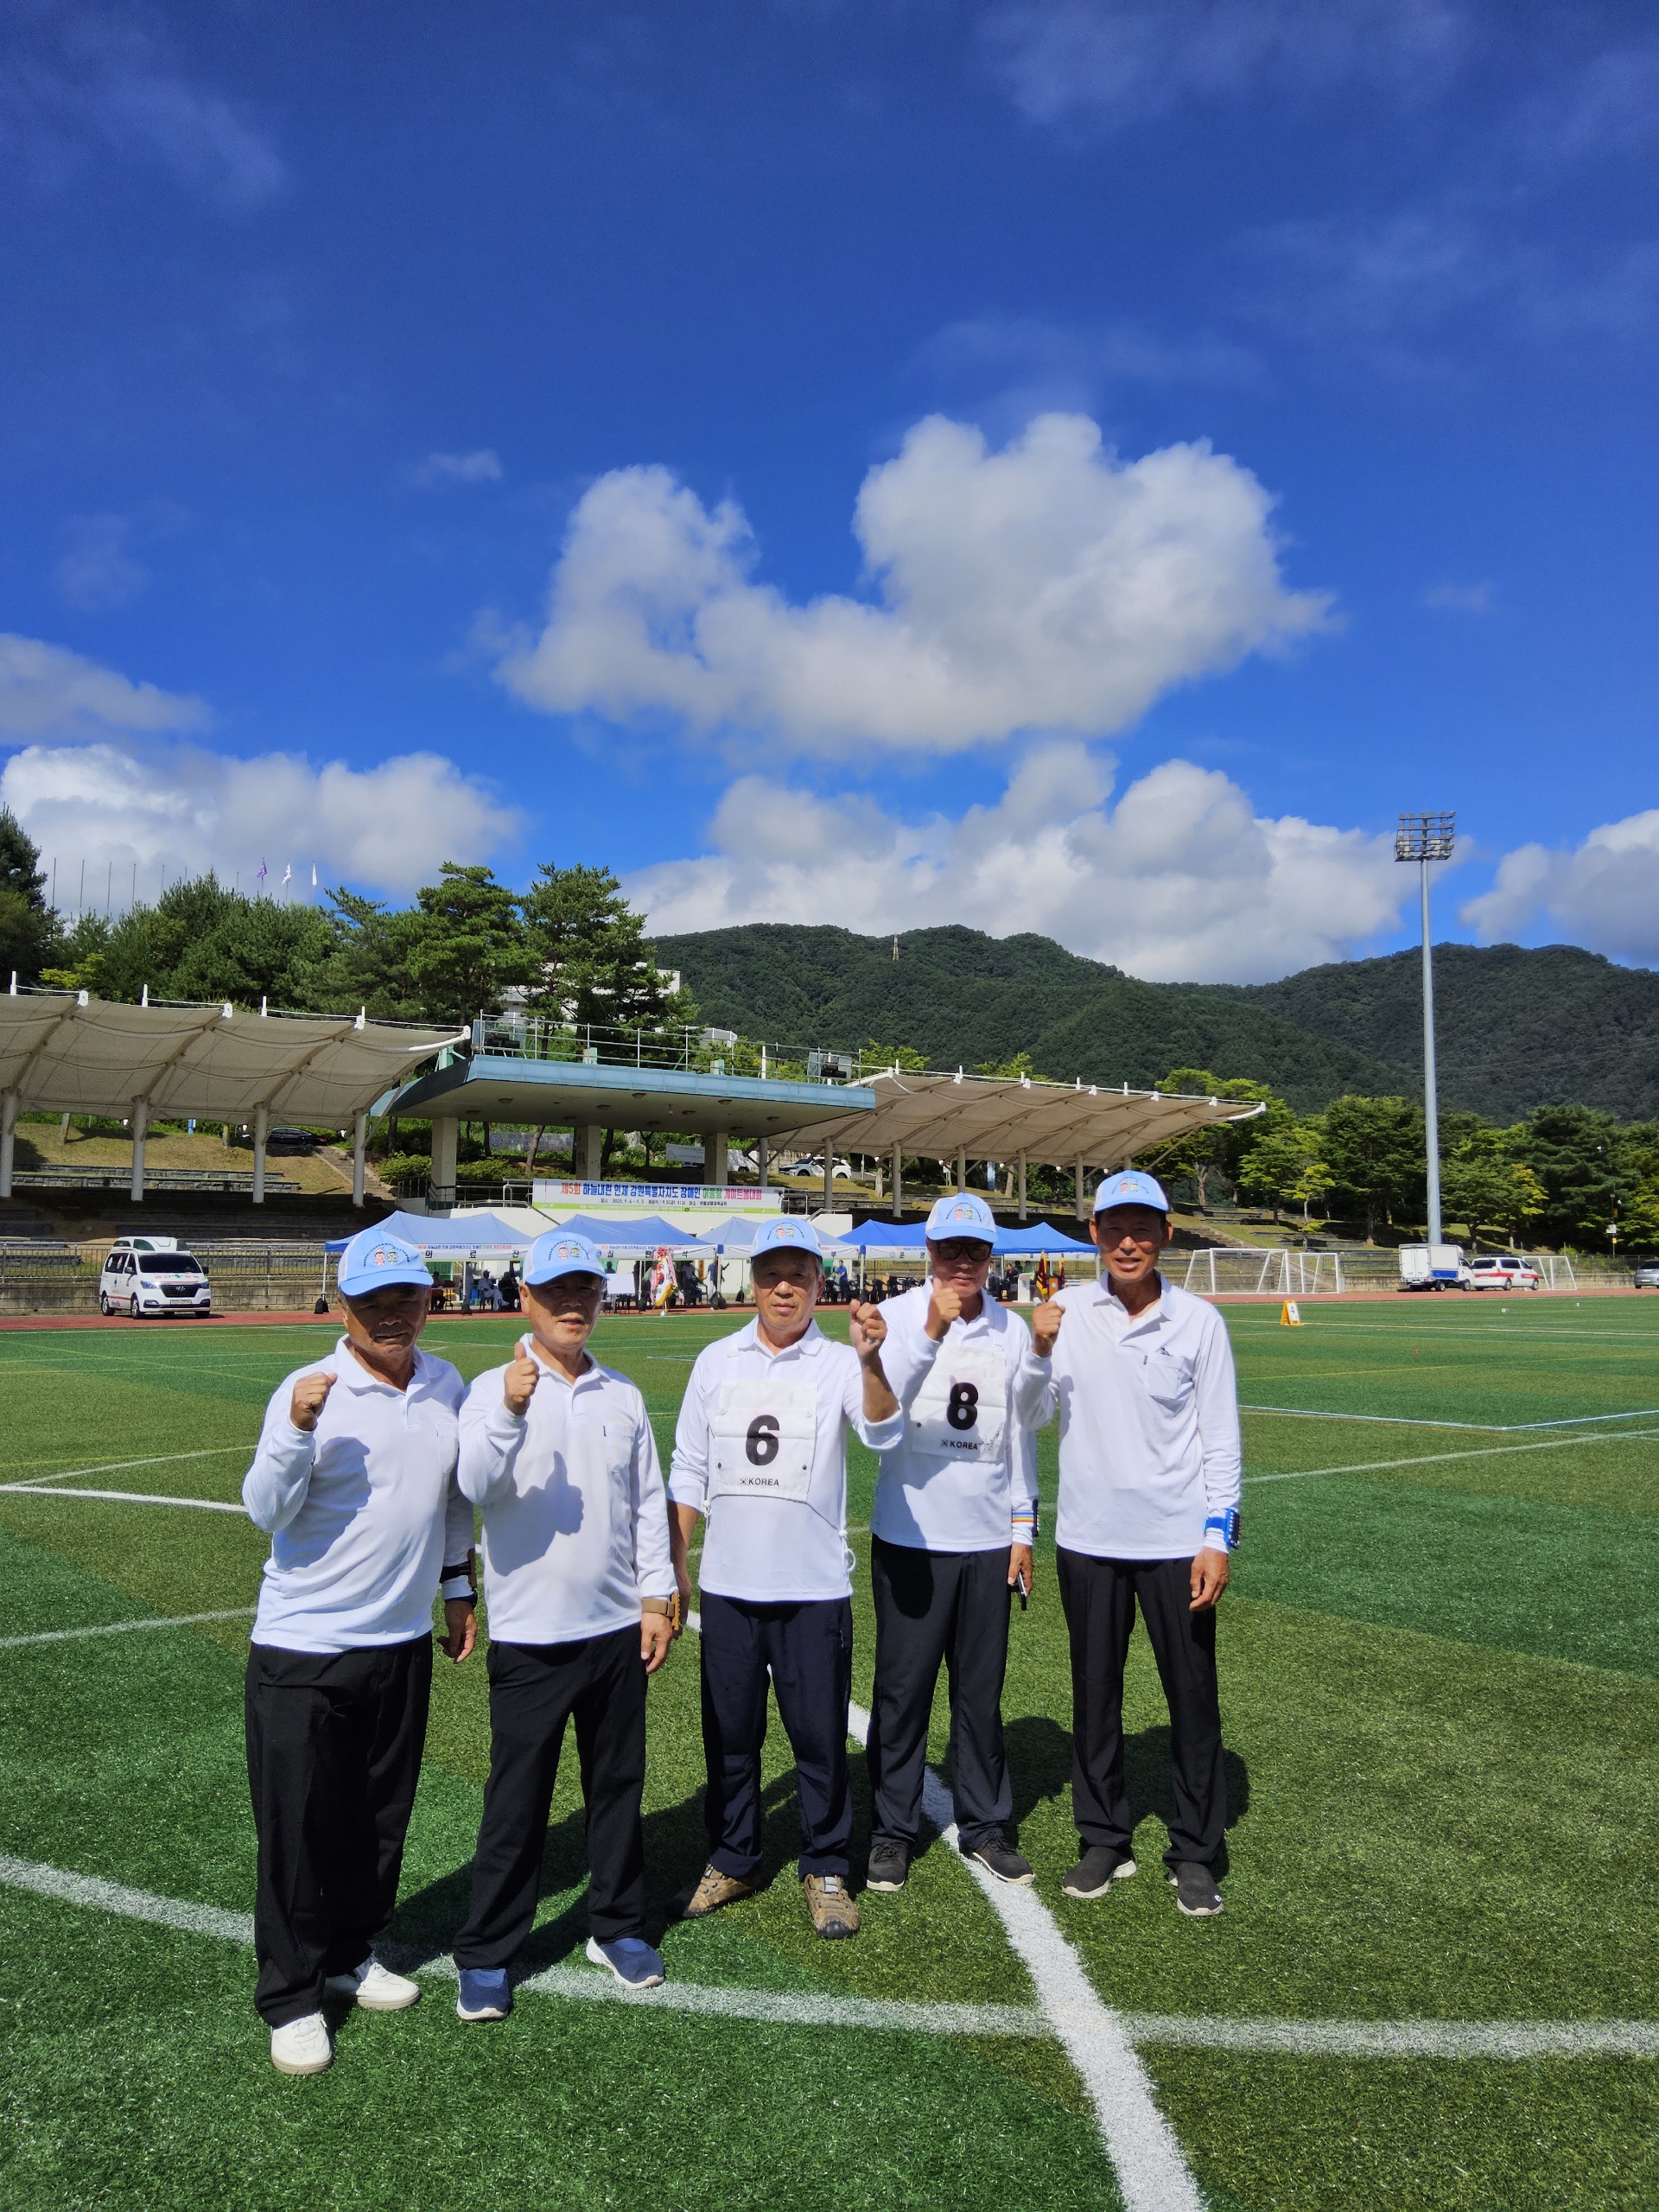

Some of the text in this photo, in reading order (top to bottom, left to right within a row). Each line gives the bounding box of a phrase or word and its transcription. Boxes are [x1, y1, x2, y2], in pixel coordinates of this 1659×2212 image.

[561, 1182, 762, 1199] 제5회 하늘내린 인제 강원특별자치도 장애인 어울림 게이트볼대회
[1290, 1306, 1295, 1314] 4
[946, 1382, 979, 1431] 8
[745, 1414, 780, 1466] 6
[950, 1440, 978, 1450] KOREA
[748, 1478, 780, 1486] KOREA
